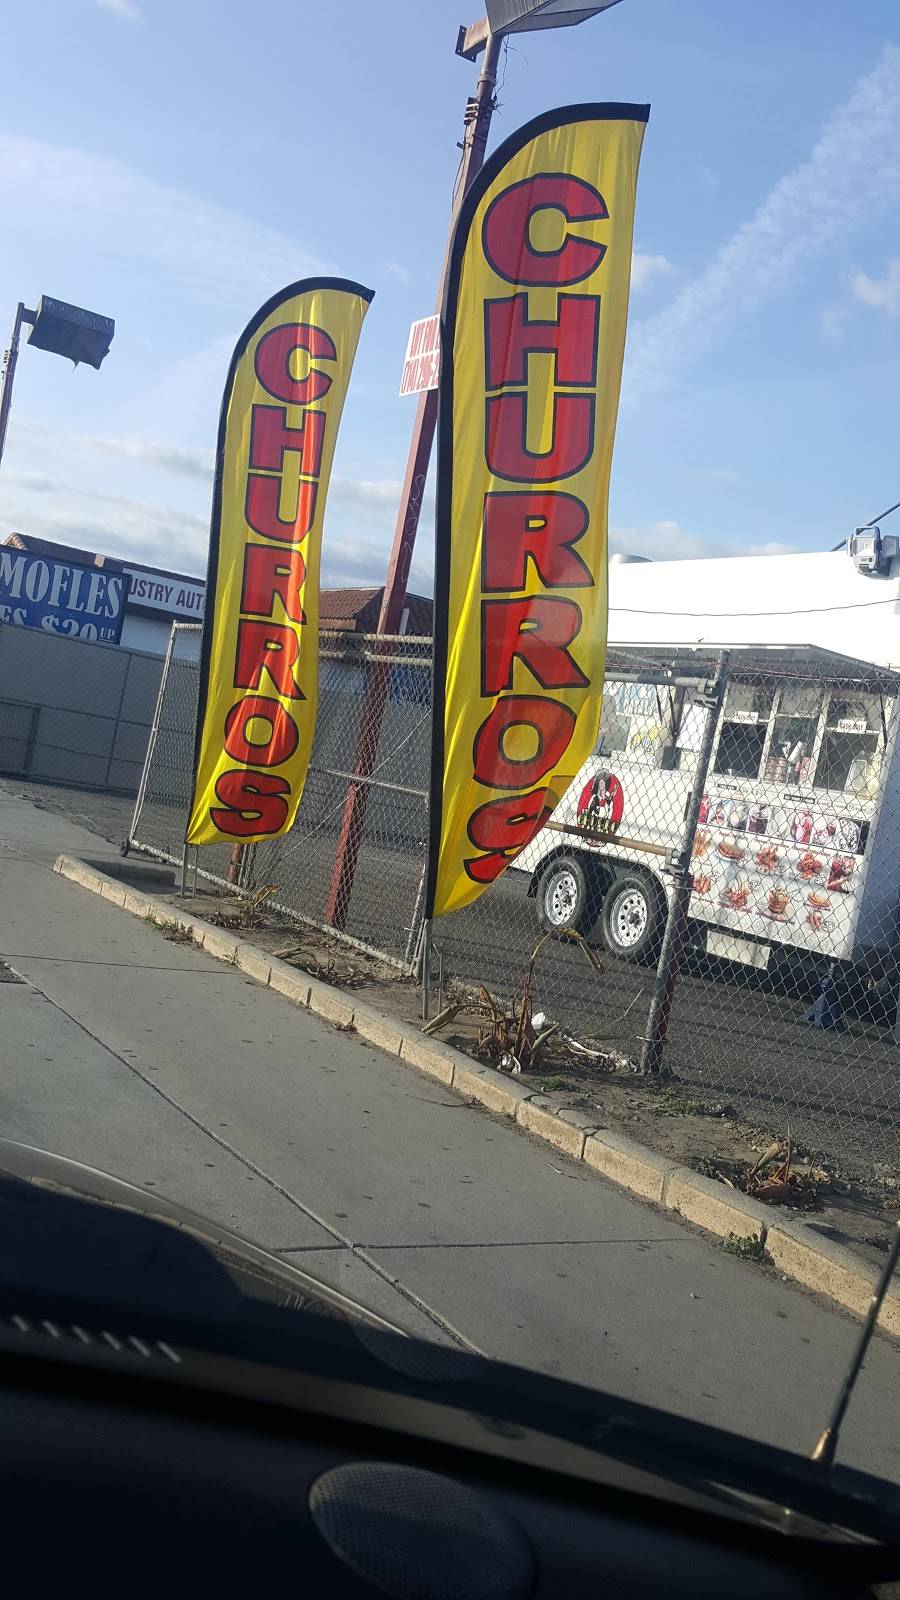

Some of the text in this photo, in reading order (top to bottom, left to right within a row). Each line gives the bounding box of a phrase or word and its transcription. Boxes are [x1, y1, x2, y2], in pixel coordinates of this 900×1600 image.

[0, 552, 123, 619] MOFLES
[100, 627, 115, 639] UP
[210, 322, 337, 837] CHURROS
[463, 172, 609, 884] CHURROS
